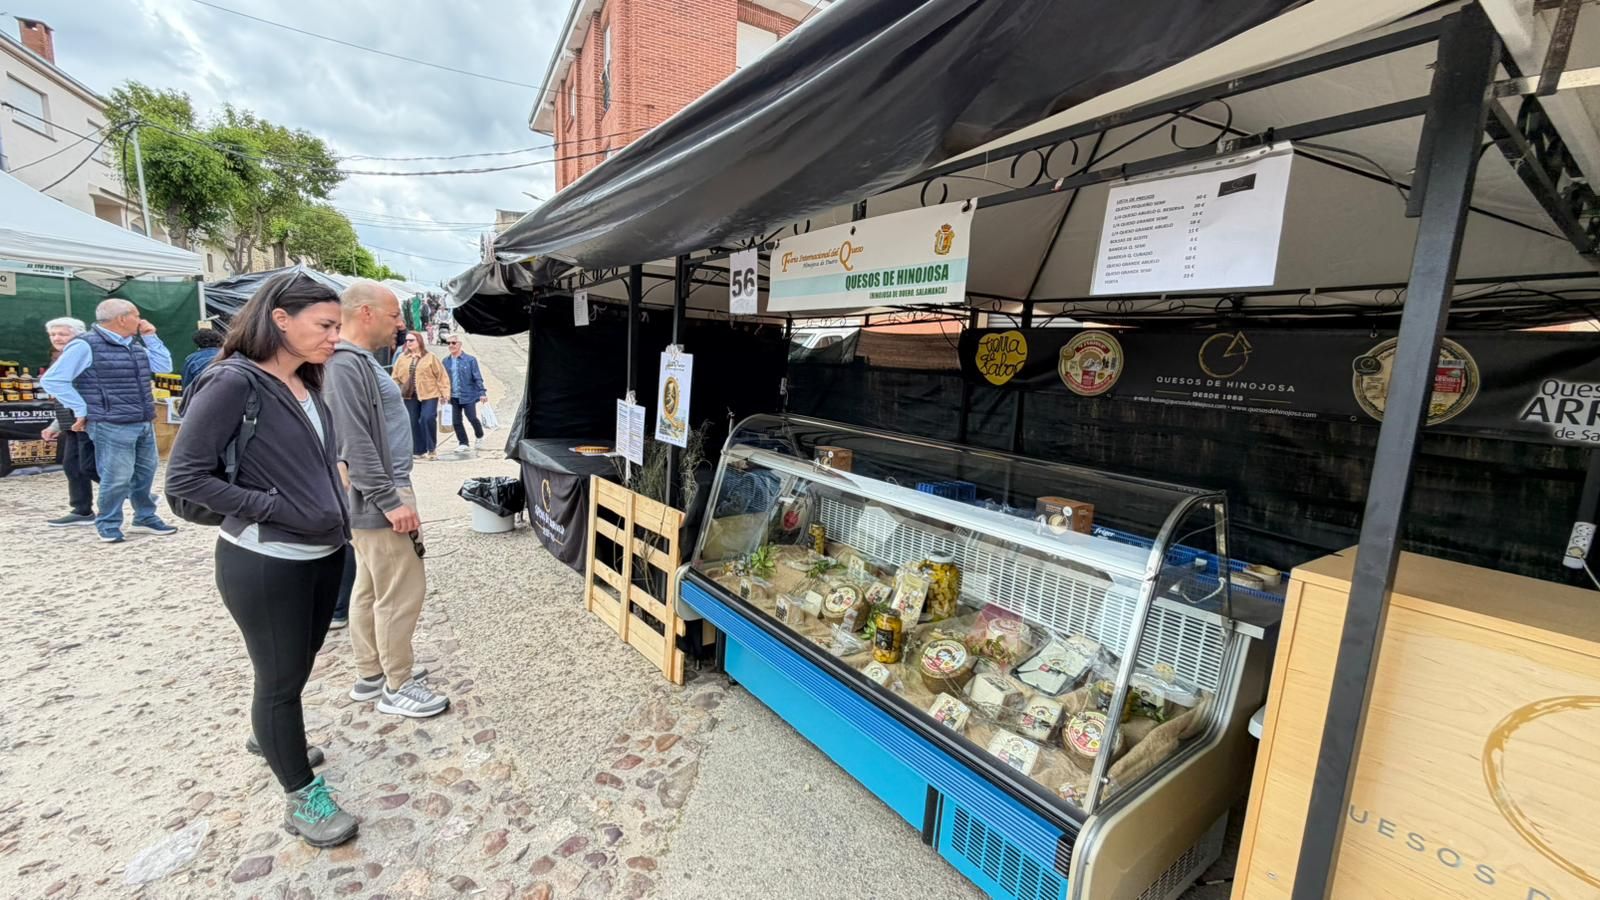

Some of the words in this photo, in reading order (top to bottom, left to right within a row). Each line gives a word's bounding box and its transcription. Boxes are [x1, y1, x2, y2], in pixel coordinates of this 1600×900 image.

[782, 252, 798, 272] Feria
[798, 248, 830, 262] Internacional
[830, 248, 840, 257] del
[840, 240, 864, 272] Queso
[732, 267, 755, 298] 56
[845, 271, 880, 291] QUESOS
[882, 270, 895, 286] DE
[896, 264, 949, 285] HINOJOSA
[892, 290, 898, 298] DE
[1156, 375, 1202, 386] QUESOS
[1206, 378, 1222, 388] DE
[1226, 380, 1296, 393] HINOJOSA
[1192, 391, 1220, 400] DESDE
[1231, 404, 1317, 419] www.quesosdehinojosa.com
[1554, 426, 1576, 439] de
[1349, 804, 1496, 885] UESOS
